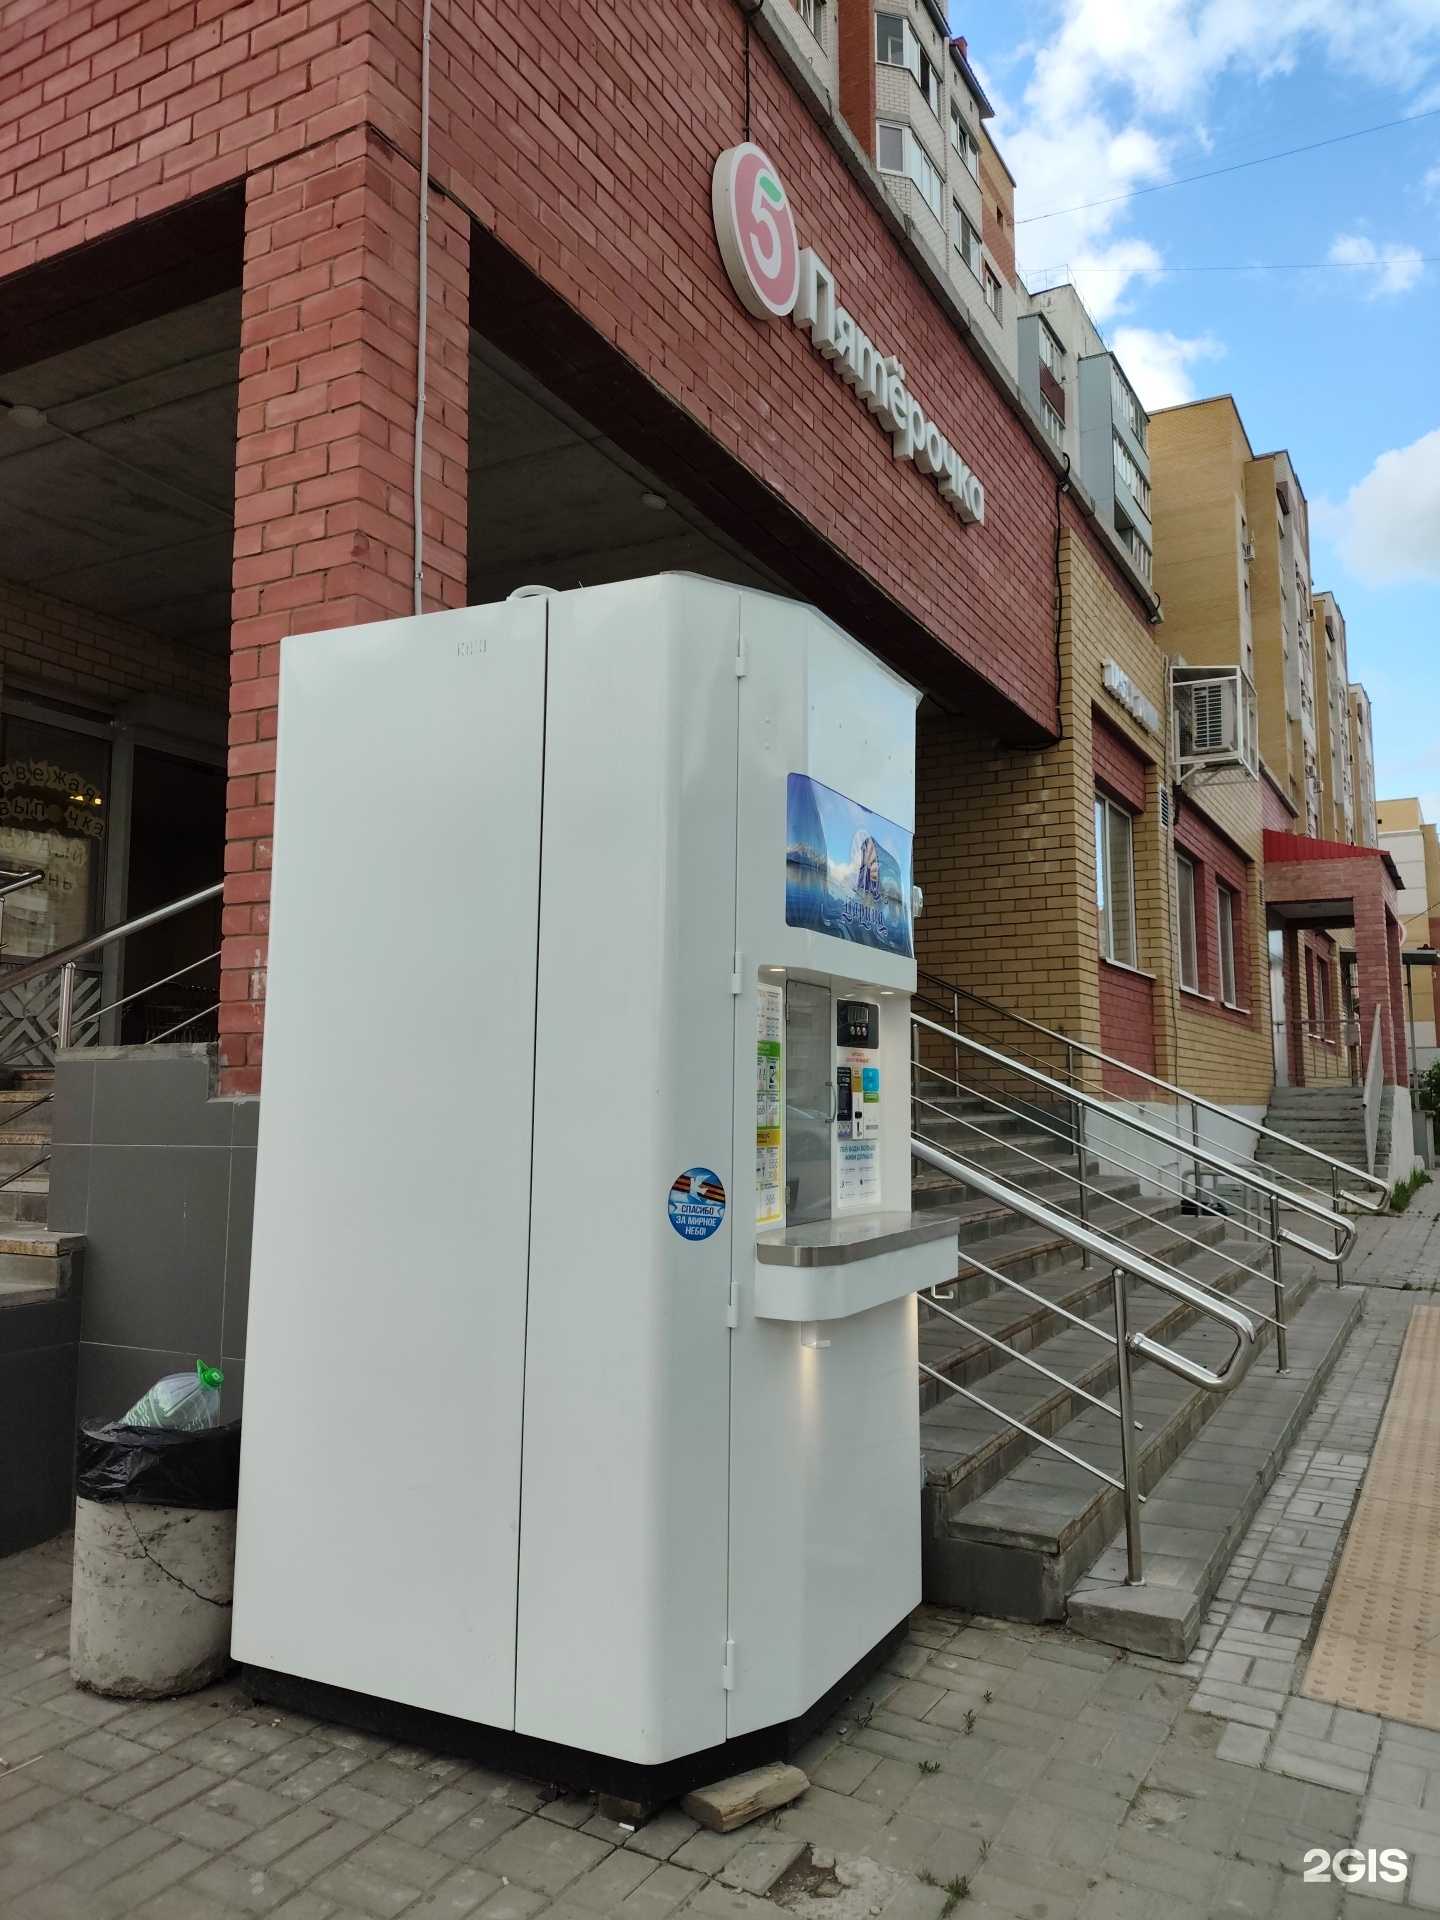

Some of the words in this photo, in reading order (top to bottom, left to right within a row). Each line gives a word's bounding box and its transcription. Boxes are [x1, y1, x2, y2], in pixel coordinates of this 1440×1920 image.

[749, 168, 785, 280] 5
[795, 247, 985, 526] Пятёрочка
[0, 800, 104, 836] выпчка
[675, 1215, 686, 1225] ЗА
[687, 1216, 717, 1227] МИРНОЕ
[681, 1204, 714, 1216] СПАСИБО
[685, 1226, 707, 1236] НЕБО!
